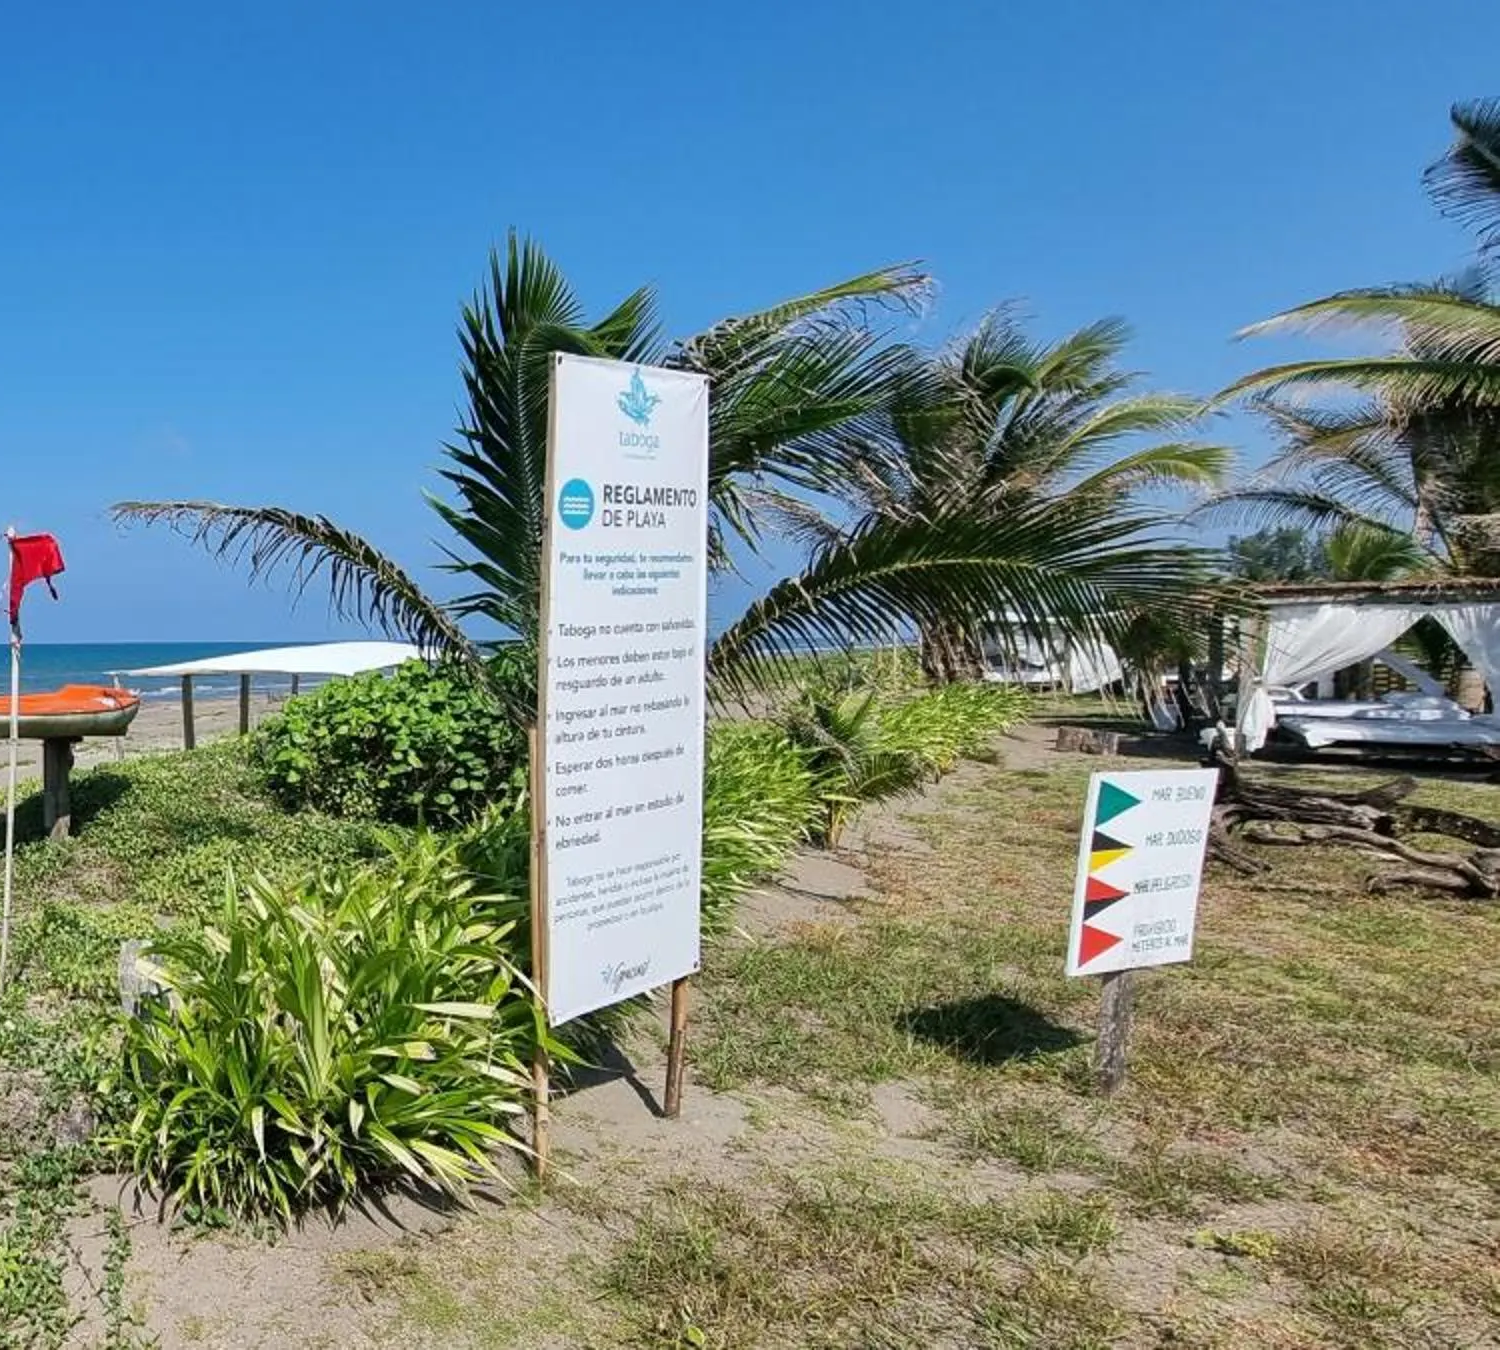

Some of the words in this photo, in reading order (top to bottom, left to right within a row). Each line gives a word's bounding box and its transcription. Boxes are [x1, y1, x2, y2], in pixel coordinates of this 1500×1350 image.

[603, 484, 697, 508] REGLAMENTO
[602, 509, 622, 527] DE
[626, 509, 666, 529] PLAYA
[559, 551, 581, 564] Para
[583, 552, 593, 564] tu
[583, 568, 607, 580] llevar
[609, 571, 614, 580] a
[615, 569, 634, 580] cabo
[558, 623, 597, 639] Taboga
[599, 625, 611, 634] no
[613, 622, 644, 634] cuenta
[645, 622, 660, 633] con
[556, 655, 575, 669] Los
[577, 654, 621, 668] menores
[622, 648, 650, 664] deben
[651, 649, 670, 661] estar
[671, 648, 687, 662] bajo
[688, 646, 695, 657] el
[555, 675, 609, 693] resguardo
[610, 674, 623, 685] de
[625, 673, 636, 682] un
[555, 707, 597, 725] Ingresar
[598, 703, 609, 717] al
[610, 702, 628, 715] mar
[630, 702, 641, 714] no
[643, 696, 682, 712] rebasando
[555, 729, 585, 744] altura
[587, 727, 601, 741] de
[602, 727, 613, 739] tu
[555, 760, 594, 776] Esperar
[595, 756, 613, 770] dos
[615, 753, 640, 766] horas
[675, 743, 685, 755] de
[1152, 786, 1173, 801] MAR
[555, 814, 571, 828] No
[573, 811, 603, 825] entrar
[605, 806, 613, 819] al
[615, 804, 633, 817] mar
[635, 802, 645, 813] en
[647, 794, 674, 810] estado
[675, 790, 685, 803] de
[1144, 831, 1163, 847] MAR
